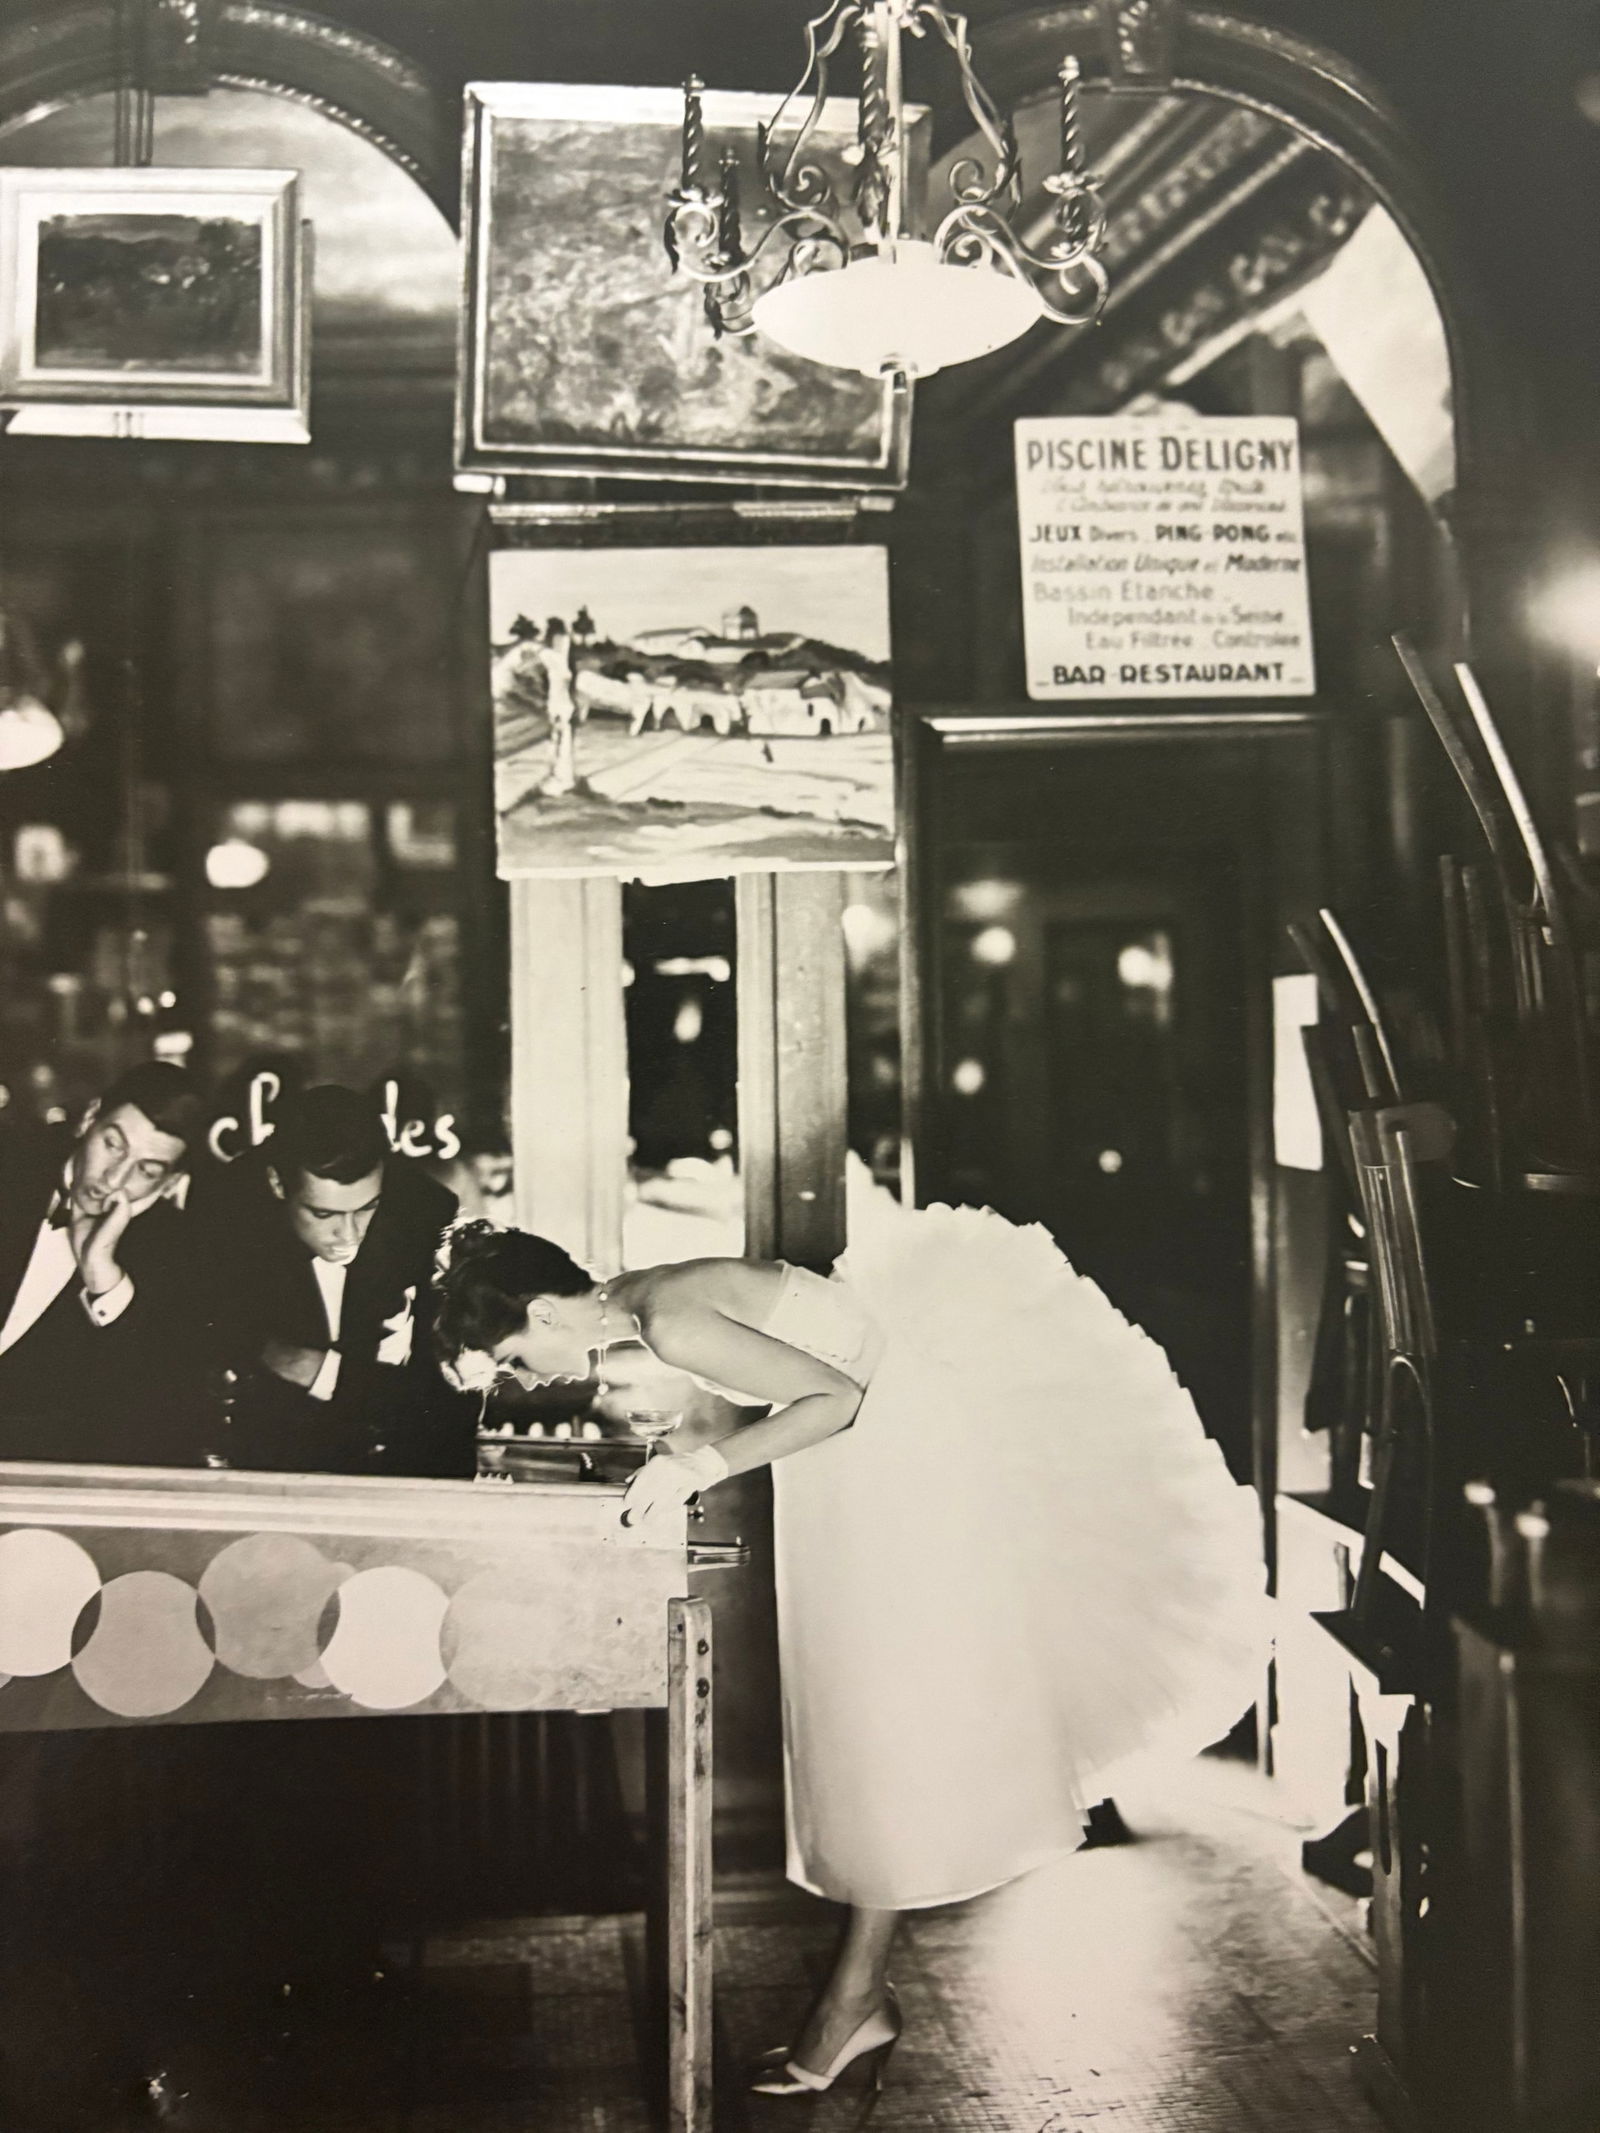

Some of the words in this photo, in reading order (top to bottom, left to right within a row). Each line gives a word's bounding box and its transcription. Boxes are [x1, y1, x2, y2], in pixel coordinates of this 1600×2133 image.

[1027, 439, 1148, 471] PISCINE
[1160, 436, 1295, 472] DELIGNY
[1029, 525, 1082, 542] JEUX
[1089, 525, 1138, 542] Divers
[1031, 555, 1128, 573] Installation
[1134, 555, 1200, 576] Unique
[1225, 554, 1301, 573] Moderne
[1033, 582, 1112, 602] Bassin
[1086, 631, 1123, 649] Eau
[1053, 665, 1106, 685] BAR
[1120, 663, 1284, 684] RESTAURANT
